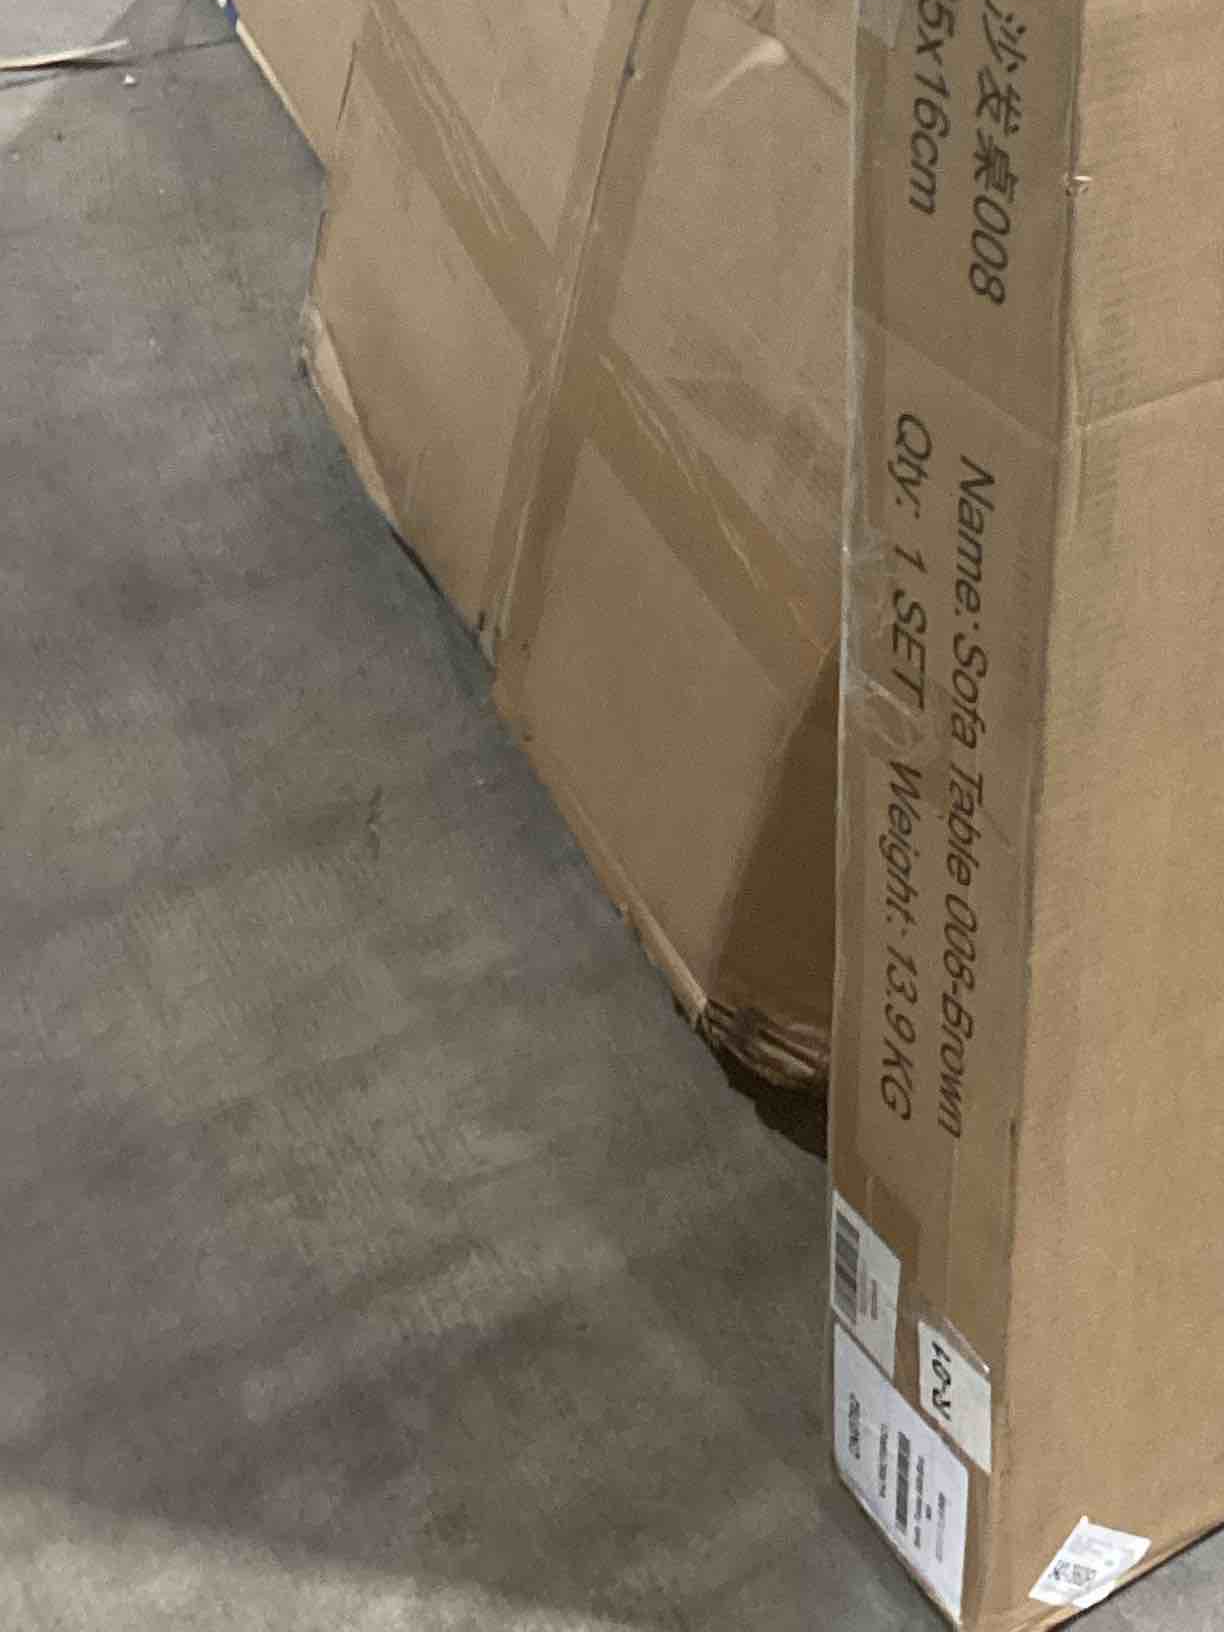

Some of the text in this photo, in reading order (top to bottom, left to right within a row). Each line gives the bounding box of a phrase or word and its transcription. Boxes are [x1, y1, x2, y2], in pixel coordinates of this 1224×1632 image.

[887, 413, 934, 520] Qty:
[895, 543, 929, 575] 1
[892, 587, 929, 712] SET
[878, 760, 923, 937] Weight:
[946, 761, 984, 887] Table
[937, 893, 979, 1139] 008-Brown
